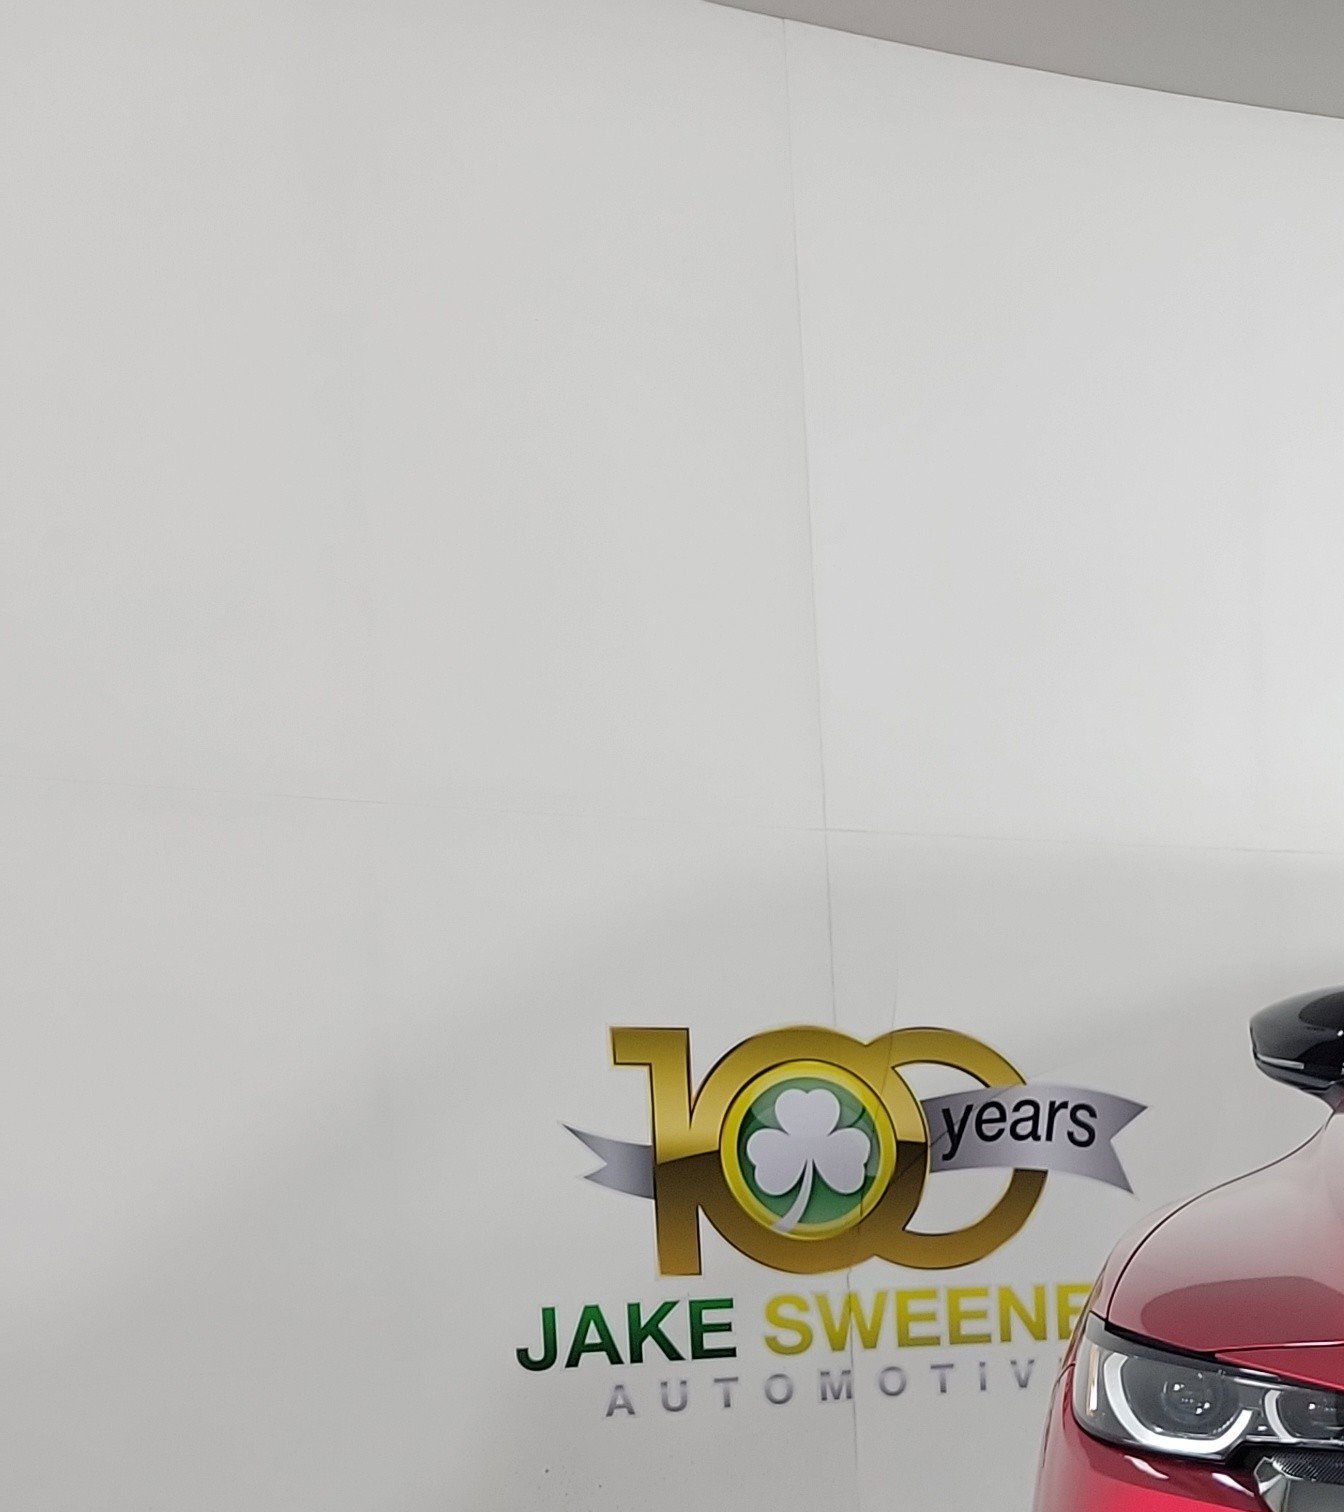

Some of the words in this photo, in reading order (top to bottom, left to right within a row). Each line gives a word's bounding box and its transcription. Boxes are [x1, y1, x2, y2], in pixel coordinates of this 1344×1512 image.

[608, 1025, 1049, 1276] 100
[940, 1097, 1099, 1162] years
[514, 1297, 738, 1372] JAKE
[763, 1284, 1094, 1356] SWEENE
[605, 1359, 1062, 1418] AUTOMOTIV
